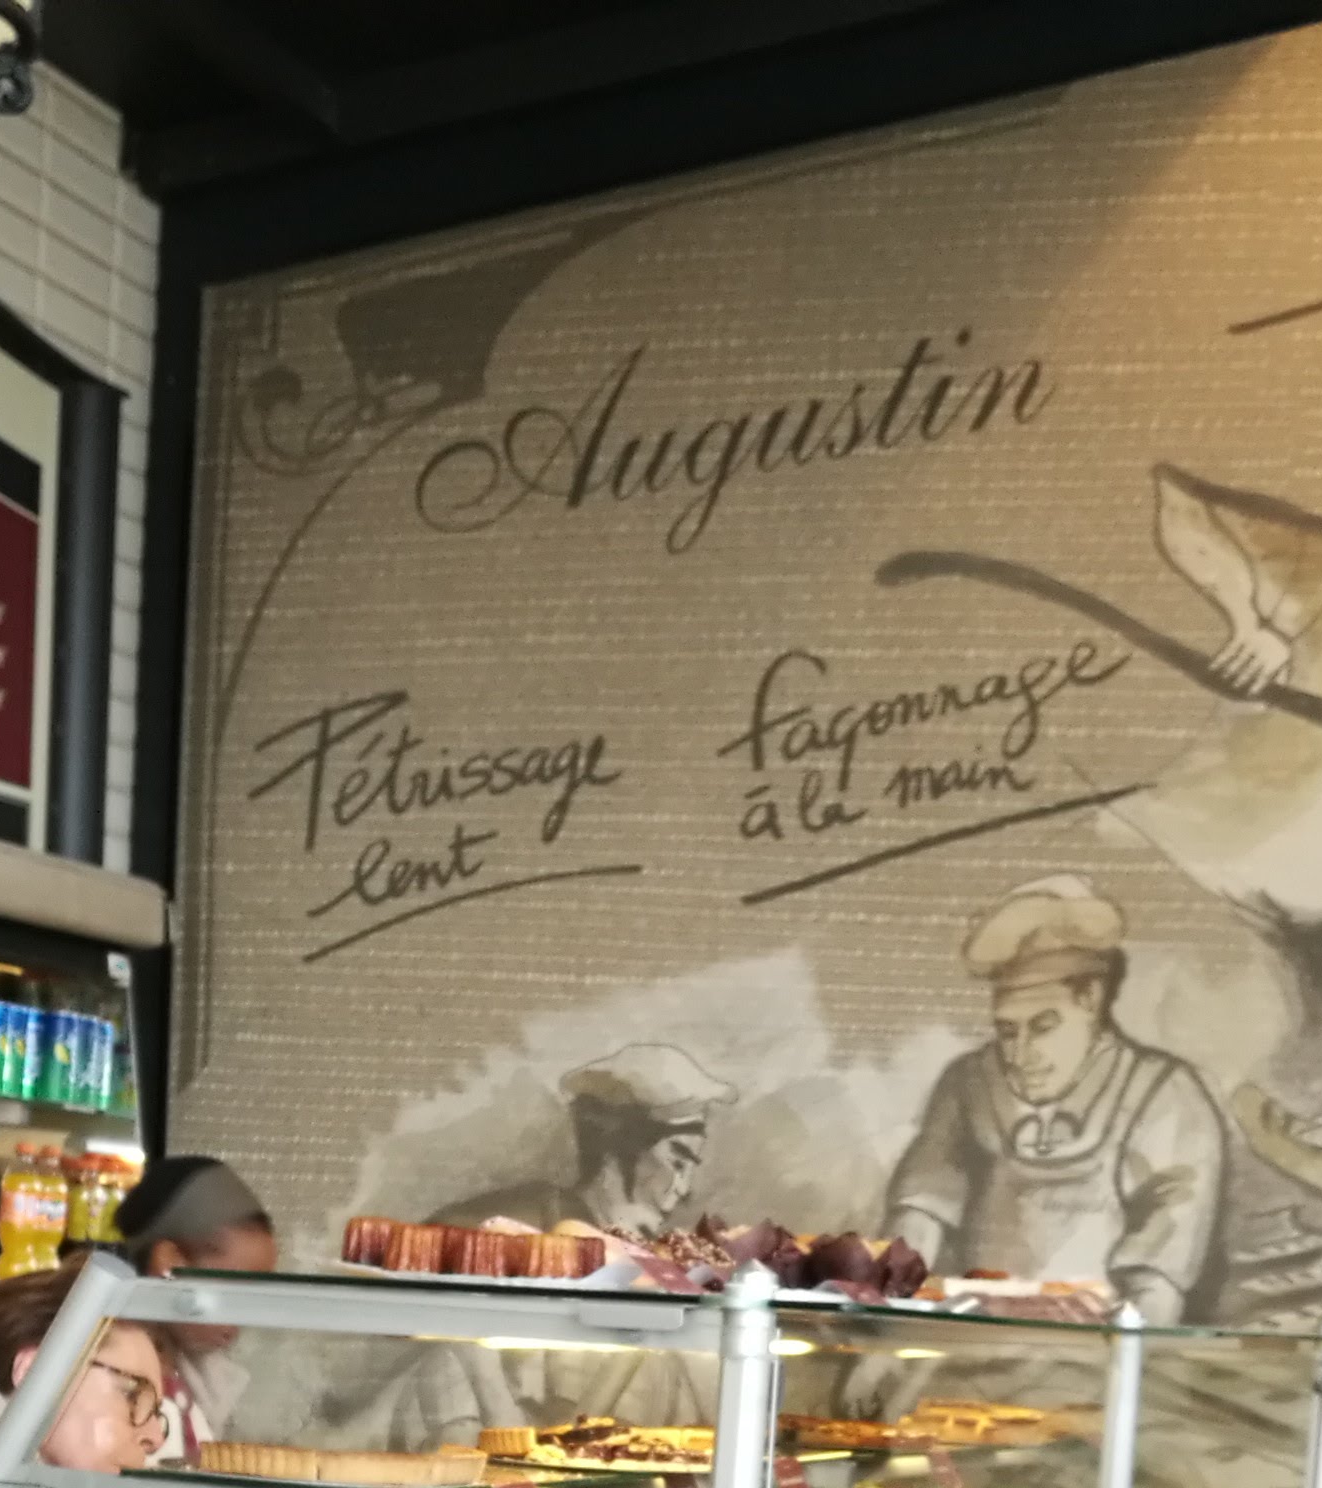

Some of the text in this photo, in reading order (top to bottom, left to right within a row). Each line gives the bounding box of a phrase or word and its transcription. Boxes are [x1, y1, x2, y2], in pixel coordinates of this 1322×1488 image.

[415, 327, 1059, 556] Augustin
[249, 690, 623, 855] Pétrissage
[798, 770, 866, 835] la
[884, 756, 1038, 809] main
[306, 829, 500, 918] lent
